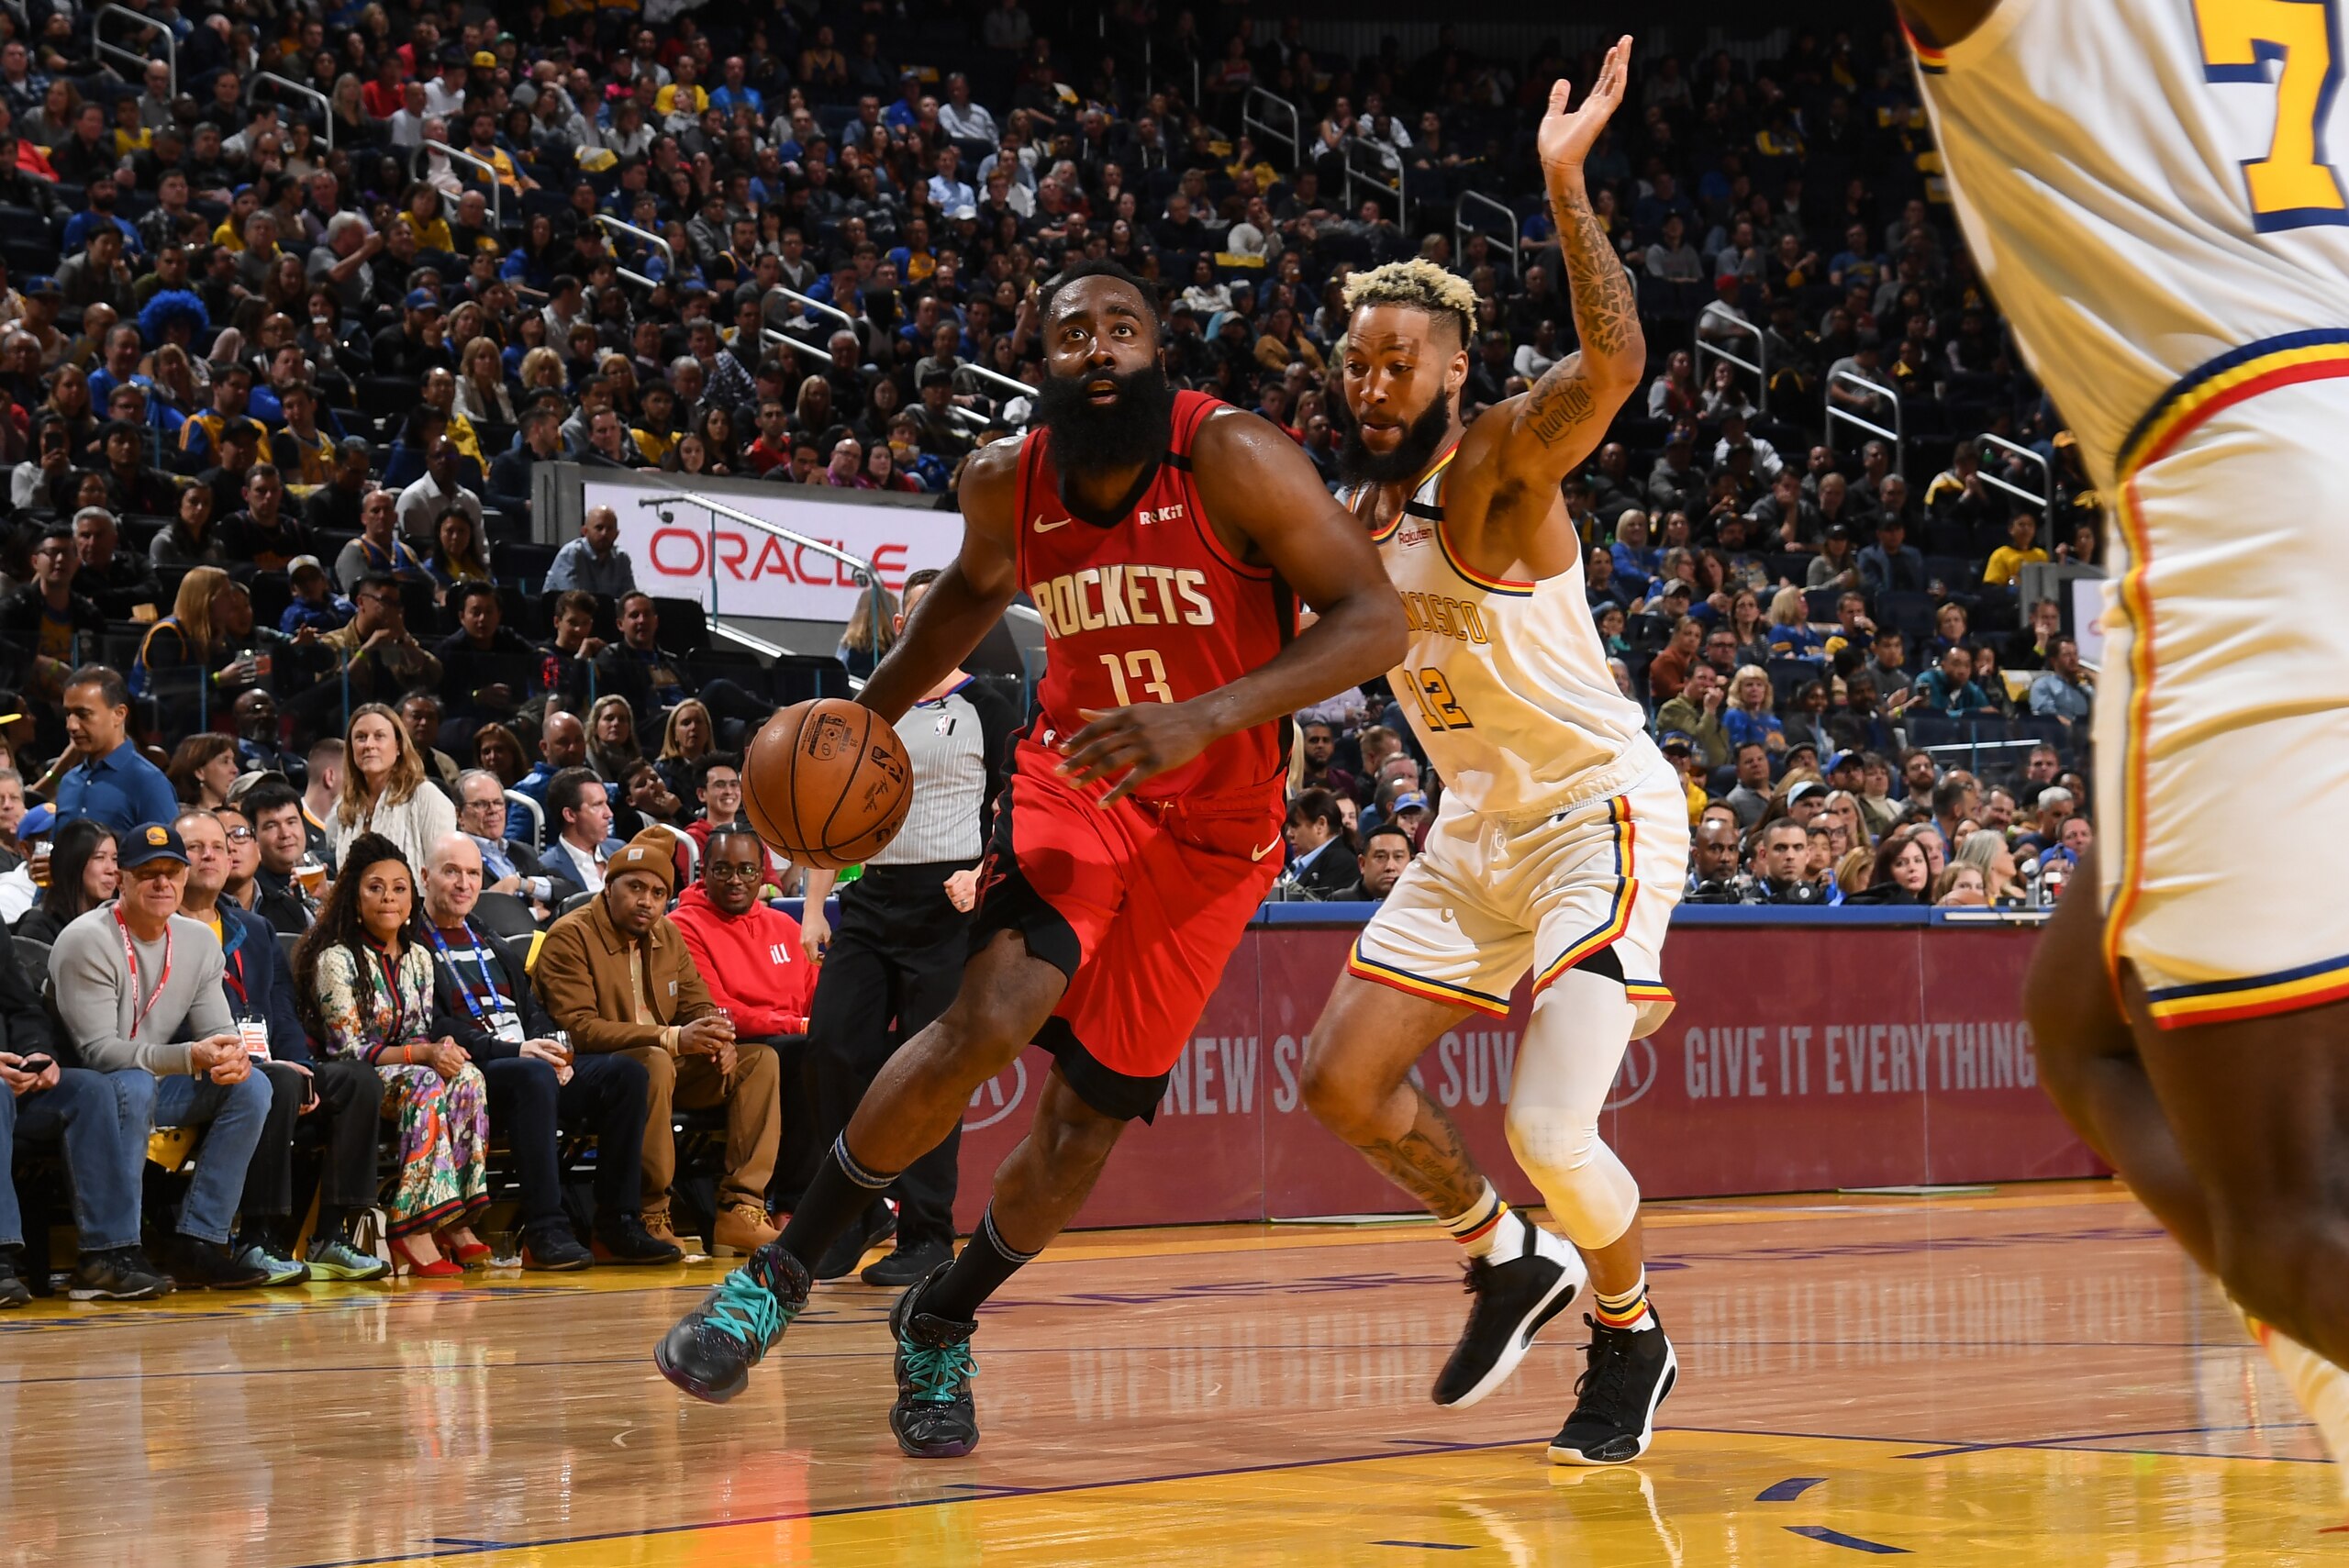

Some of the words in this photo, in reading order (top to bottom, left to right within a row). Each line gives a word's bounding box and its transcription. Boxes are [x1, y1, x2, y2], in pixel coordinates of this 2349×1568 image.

[2191, 0, 2349, 233] 7
[650, 528, 908, 589] ORACLE
[1397, 528, 1433, 544] Rakuten
[1030, 563, 1215, 639] ROCKETS
[1401, 591, 1488, 644] NCISCO
[1099, 649, 1174, 706] 13
[1404, 667, 1474, 732] 12
[769, 942, 791, 964] ill
[1163, 1036, 1257, 1116] NEW
[1439, 1031, 1516, 1107] SUV
[1685, 1027, 1766, 1099] GIVE
[1780, 1026, 1812, 1095] IT
[1826, 1020, 2037, 1094] EVERYTHING
